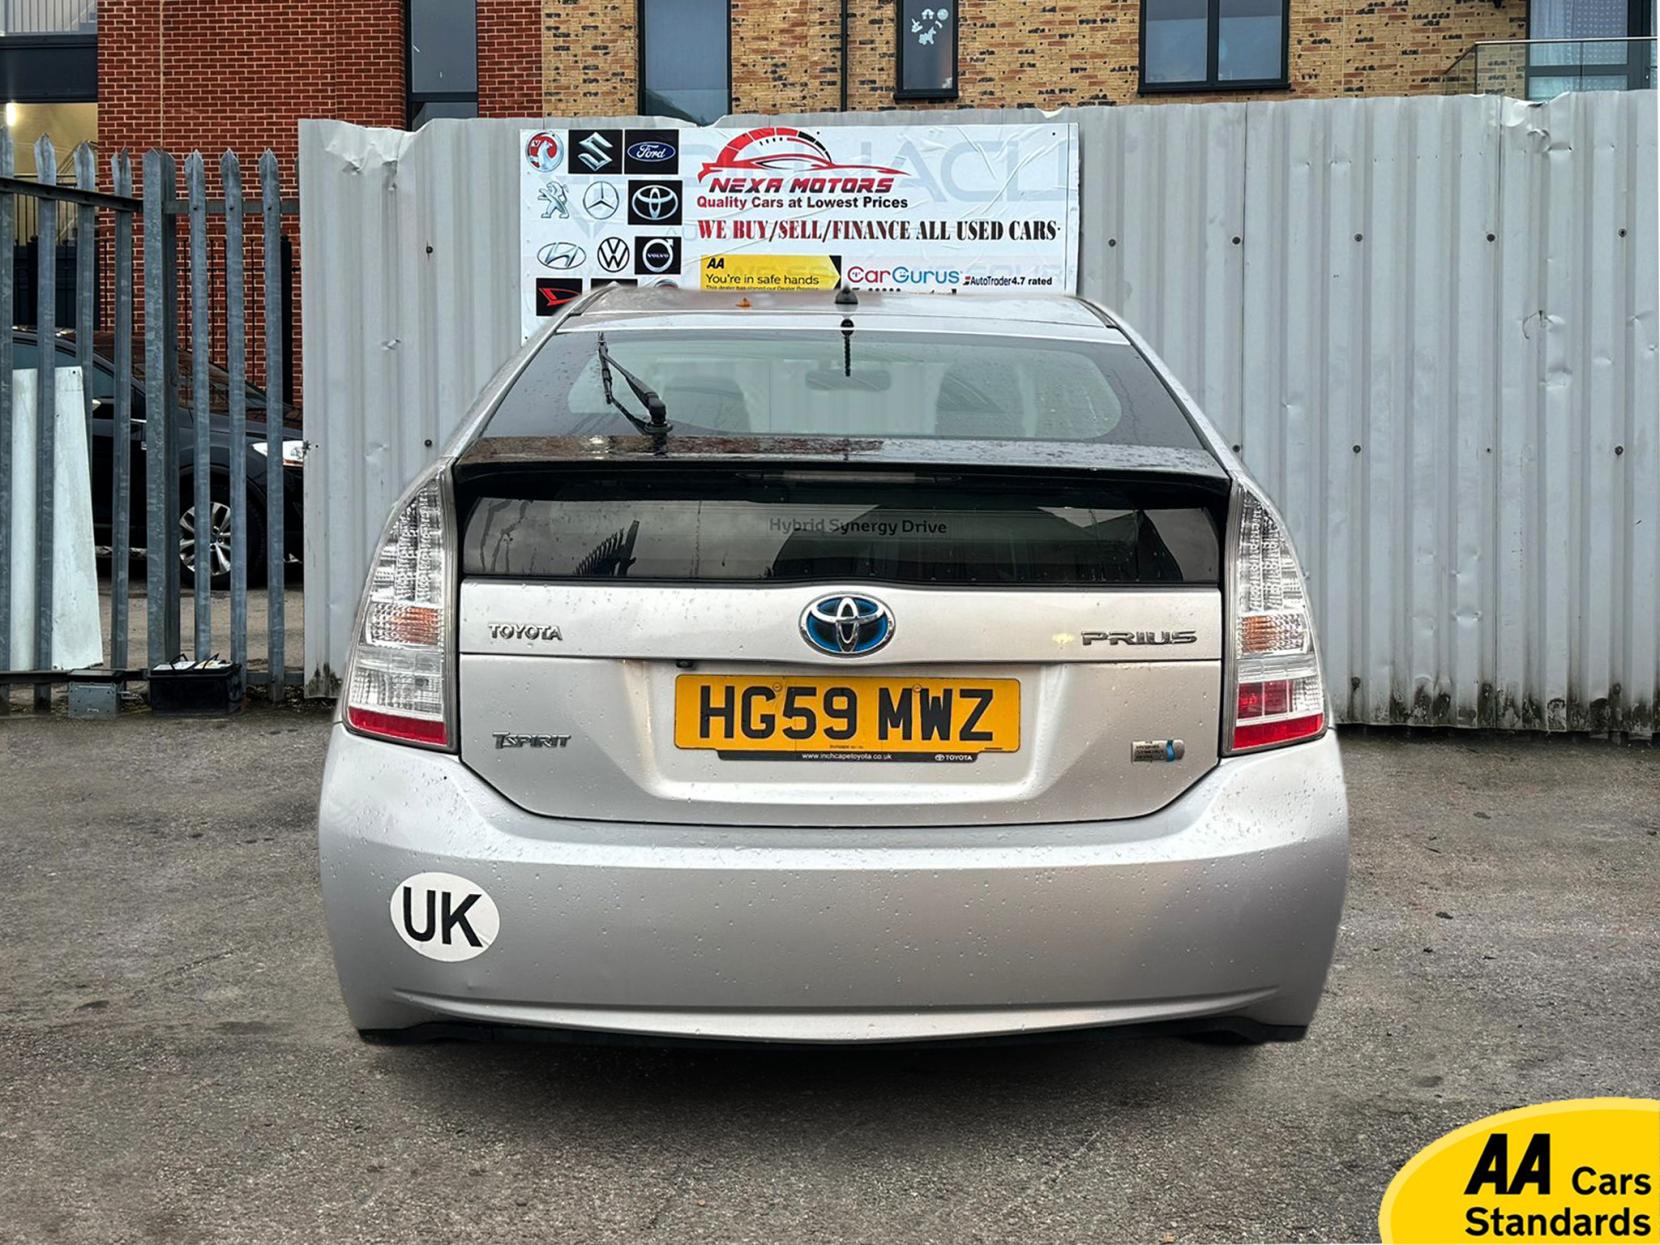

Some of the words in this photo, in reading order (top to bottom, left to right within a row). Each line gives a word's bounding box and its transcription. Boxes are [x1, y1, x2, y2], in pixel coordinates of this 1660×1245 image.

[636, 144, 666, 159] Ford
[709, 177, 784, 193] NEXA
[789, 177, 894, 193] MOTORS
[697, 196, 747, 210] Quality
[751, 196, 784, 208] Cars
[788, 197, 803, 208] at
[807, 196, 859, 209] Lowest
[863, 196, 908, 208] Prices
[697, 220, 727, 240] WE
[915, 220, 951, 240] ALL
[956, 220, 1004, 240] USED
[1009, 220, 1057, 241] CARS
[706, 257, 725, 269] AA
[706, 274, 741, 284] You're
[744, 274, 754, 284] in
[757, 274, 781, 284] safe
[784, 275, 820, 285] hands
[847, 266, 960, 284] CarGurus
[1028, 277, 1053, 285] rated
[769, 518, 825, 535] Hybrid
[829, 518, 898, 536] Synergy
[902, 520, 948, 534] Drive
[488, 623, 563, 641] TOYOTA
[1082, 630, 1198, 646] PRIUS
[699, 685, 858, 740] HG59
[878, 687, 994, 741] MWZ
[403, 886, 483, 947] UK
